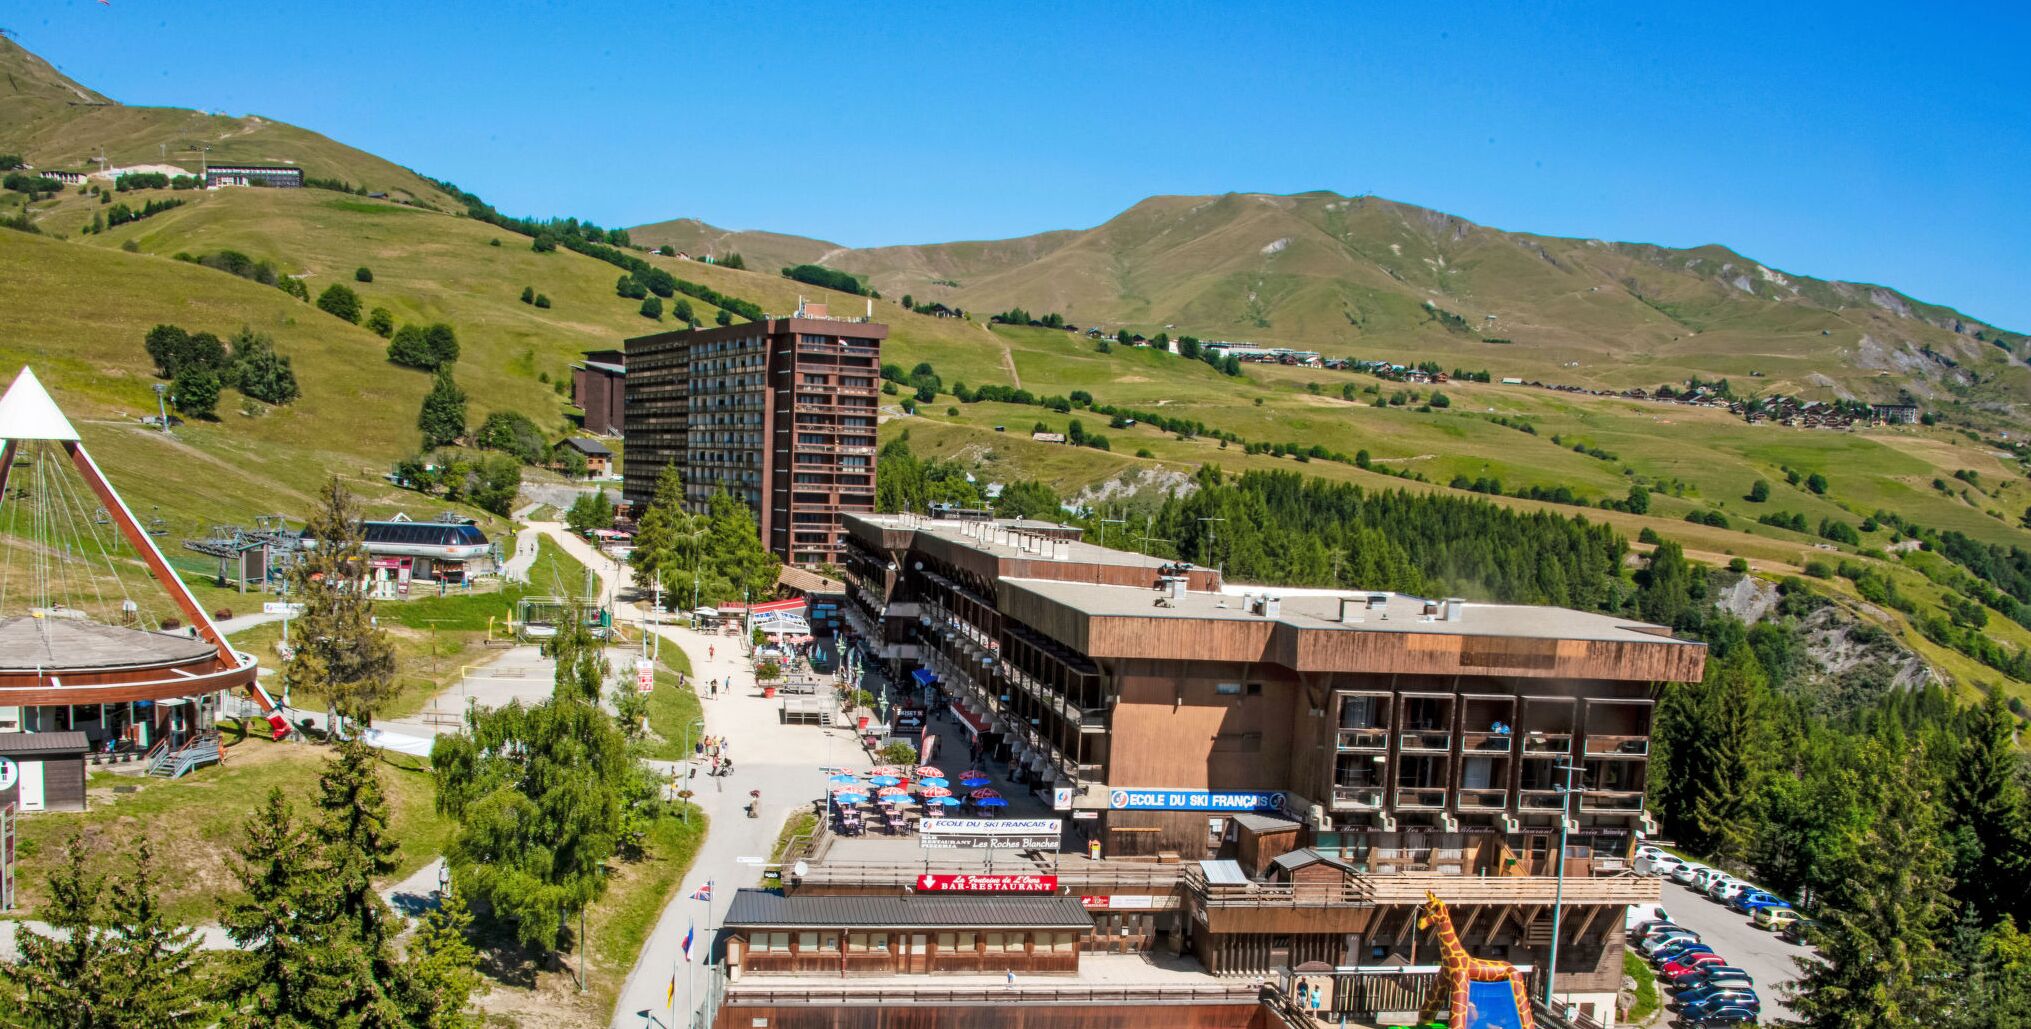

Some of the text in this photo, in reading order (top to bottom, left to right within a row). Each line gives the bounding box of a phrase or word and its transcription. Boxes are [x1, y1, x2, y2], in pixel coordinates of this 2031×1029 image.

[1130, 795, 1268, 808] ECOLE DU SKI FRANÇAIS
[972, 838, 1059, 848] Les Roches Blanches
